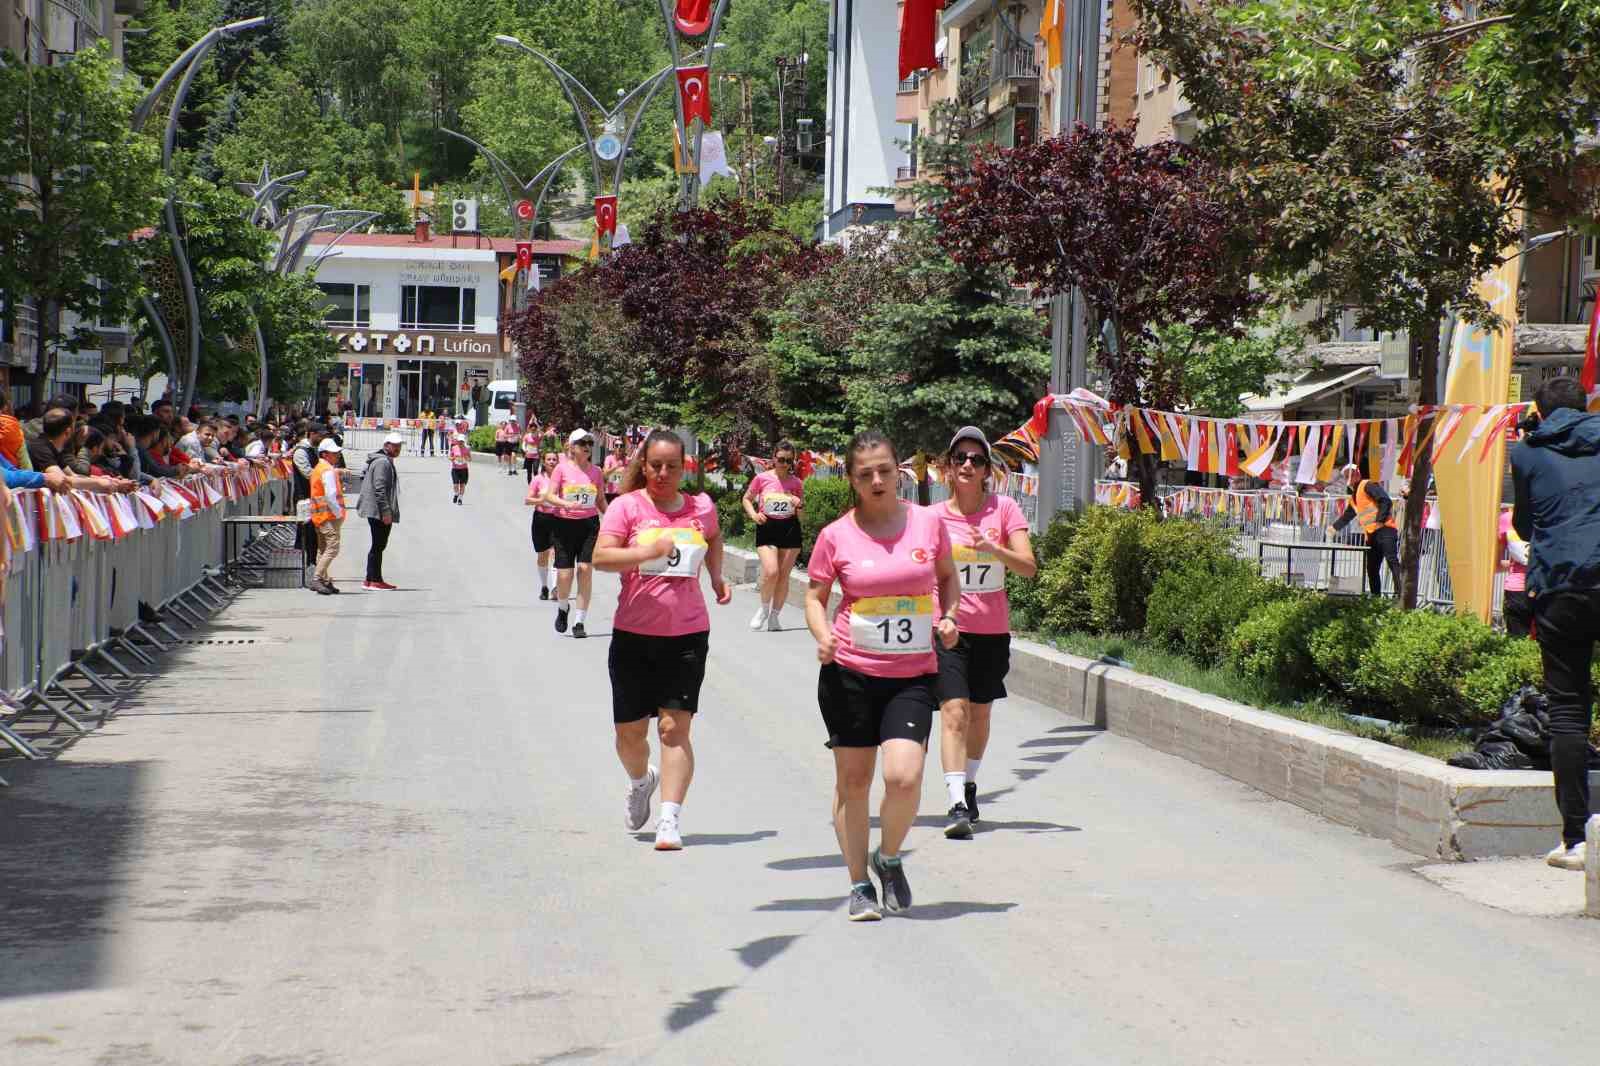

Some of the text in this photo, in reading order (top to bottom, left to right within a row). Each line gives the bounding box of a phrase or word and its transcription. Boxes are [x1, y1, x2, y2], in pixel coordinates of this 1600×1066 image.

[444, 337, 491, 353] Lufian
[773, 501, 788, 512] 22
[667, 546, 681, 567] 9
[960, 564, 991, 585] 17
[877, 618, 913, 644] 13
